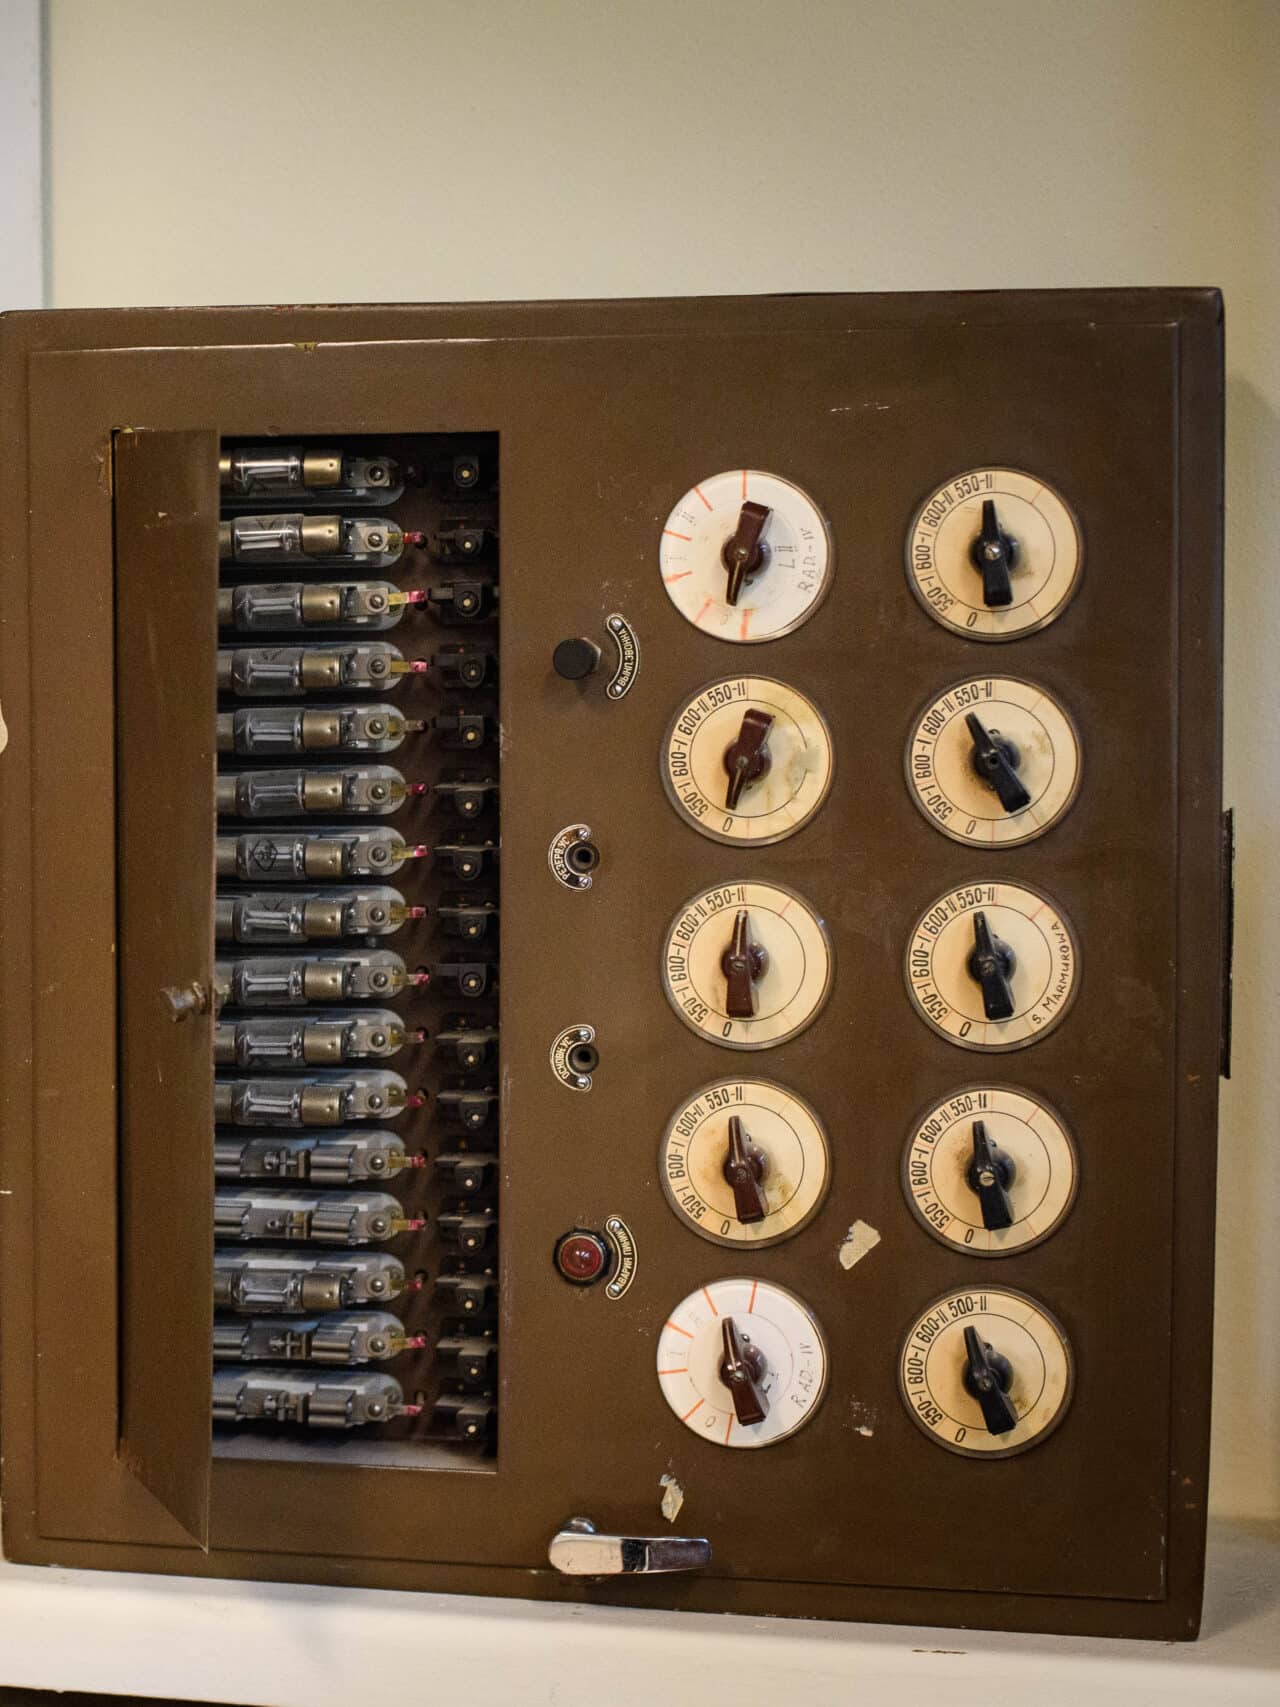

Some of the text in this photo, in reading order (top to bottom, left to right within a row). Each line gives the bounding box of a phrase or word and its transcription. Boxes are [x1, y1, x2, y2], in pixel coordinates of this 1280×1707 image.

[966, 612, 978, 627] 0
[722, 816, 733, 832] 0
[965, 820, 976, 835] 0
[722, 1021, 732, 1037] 0
[959, 1021, 971, 1037] 0
[720, 1220, 730, 1235] 0
[964, 1229, 974, 1243] 0
[955, 1427, 966, 1443] 0
